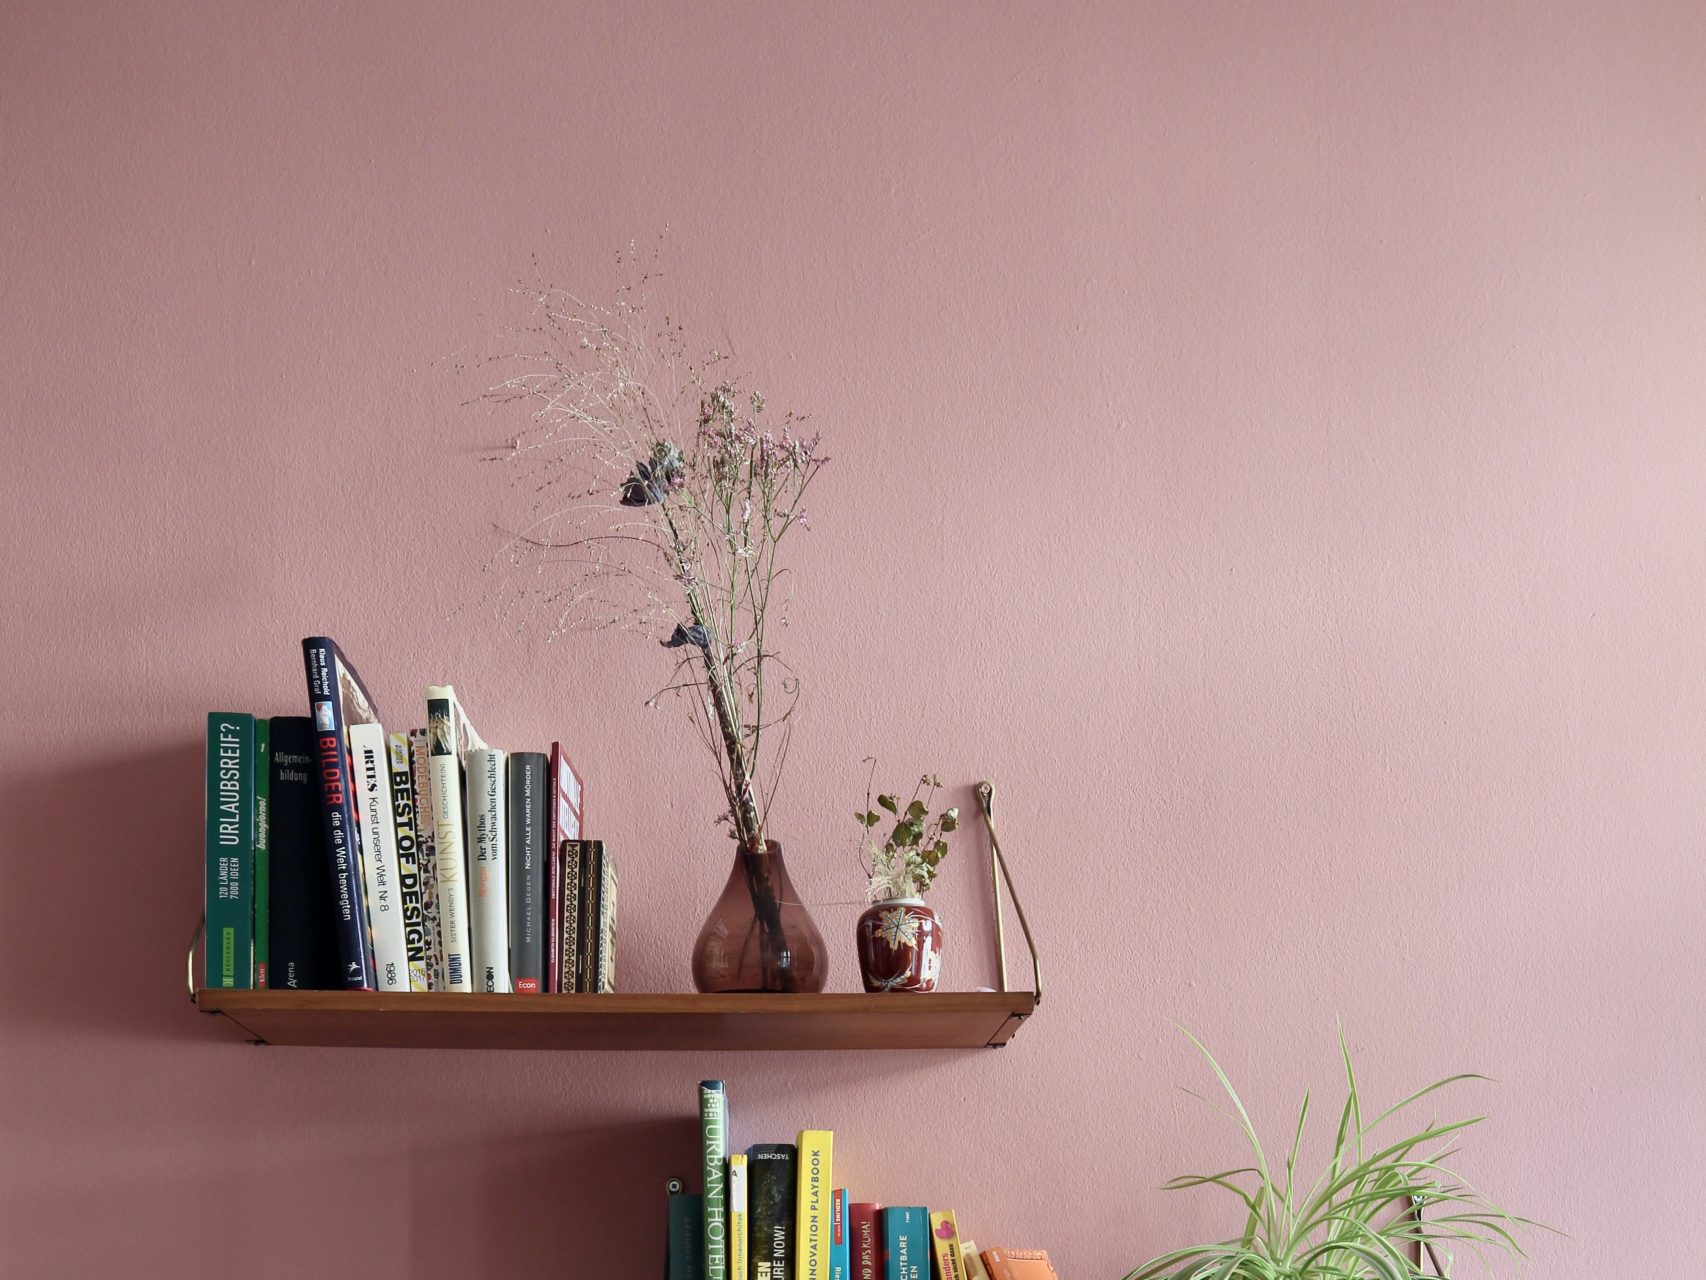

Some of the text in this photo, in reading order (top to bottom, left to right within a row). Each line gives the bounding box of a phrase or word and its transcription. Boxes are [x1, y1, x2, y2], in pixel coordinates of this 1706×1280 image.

[309, 648, 322, 694] Bernhard Graf
[318, 648, 331, 695] Klaus Reichold
[219, 722, 240, 846] URLAUBSREIF?
[280, 769, 308, 784] bildung
[362, 744, 379, 793] ARTES
[487, 753, 497, 798] Geschlecht
[524, 764, 532, 797] MÖRDER
[256, 796, 268, 850] buongiorno!
[368, 797, 380, 825] Kunst
[487, 798, 498, 843] Schwachen
[319, 737, 352, 921] BILDER die die Welt bewegten
[371, 827, 384, 864] unserer
[477, 814, 488, 844] Mythos
[391, 770, 425, 963] BEST OF DESIGN
[437, 763, 459, 943] SISTER WENDY'S KUNST GESCHICHTE(N)
[477, 846, 487, 861] Der
[218, 857, 229, 899] 120 LÄNDER
[229, 857, 239, 899] 7000 IDEEN
[376, 864, 386, 888] Welt
[287, 962, 298, 988] Arena
[386, 962, 397, 986] 1986
[448, 953, 463, 985] DUMONT
[486, 966, 495, 993] ECON
[518, 981, 537, 990] Econ
[706, 1125, 725, 1200] URBAN
[810, 1150, 820, 1211] PLAYBOOK
[708, 1207, 725, 1277] HOTEL
[773, 1226, 786, 1258] NOW!
[861, 1221, 871, 1249] KLIMA!
[948, 1242, 956, 1258] dazu
[861, 1249, 872, 1265] DAS
[950, 1257, 959, 1274] nicht
